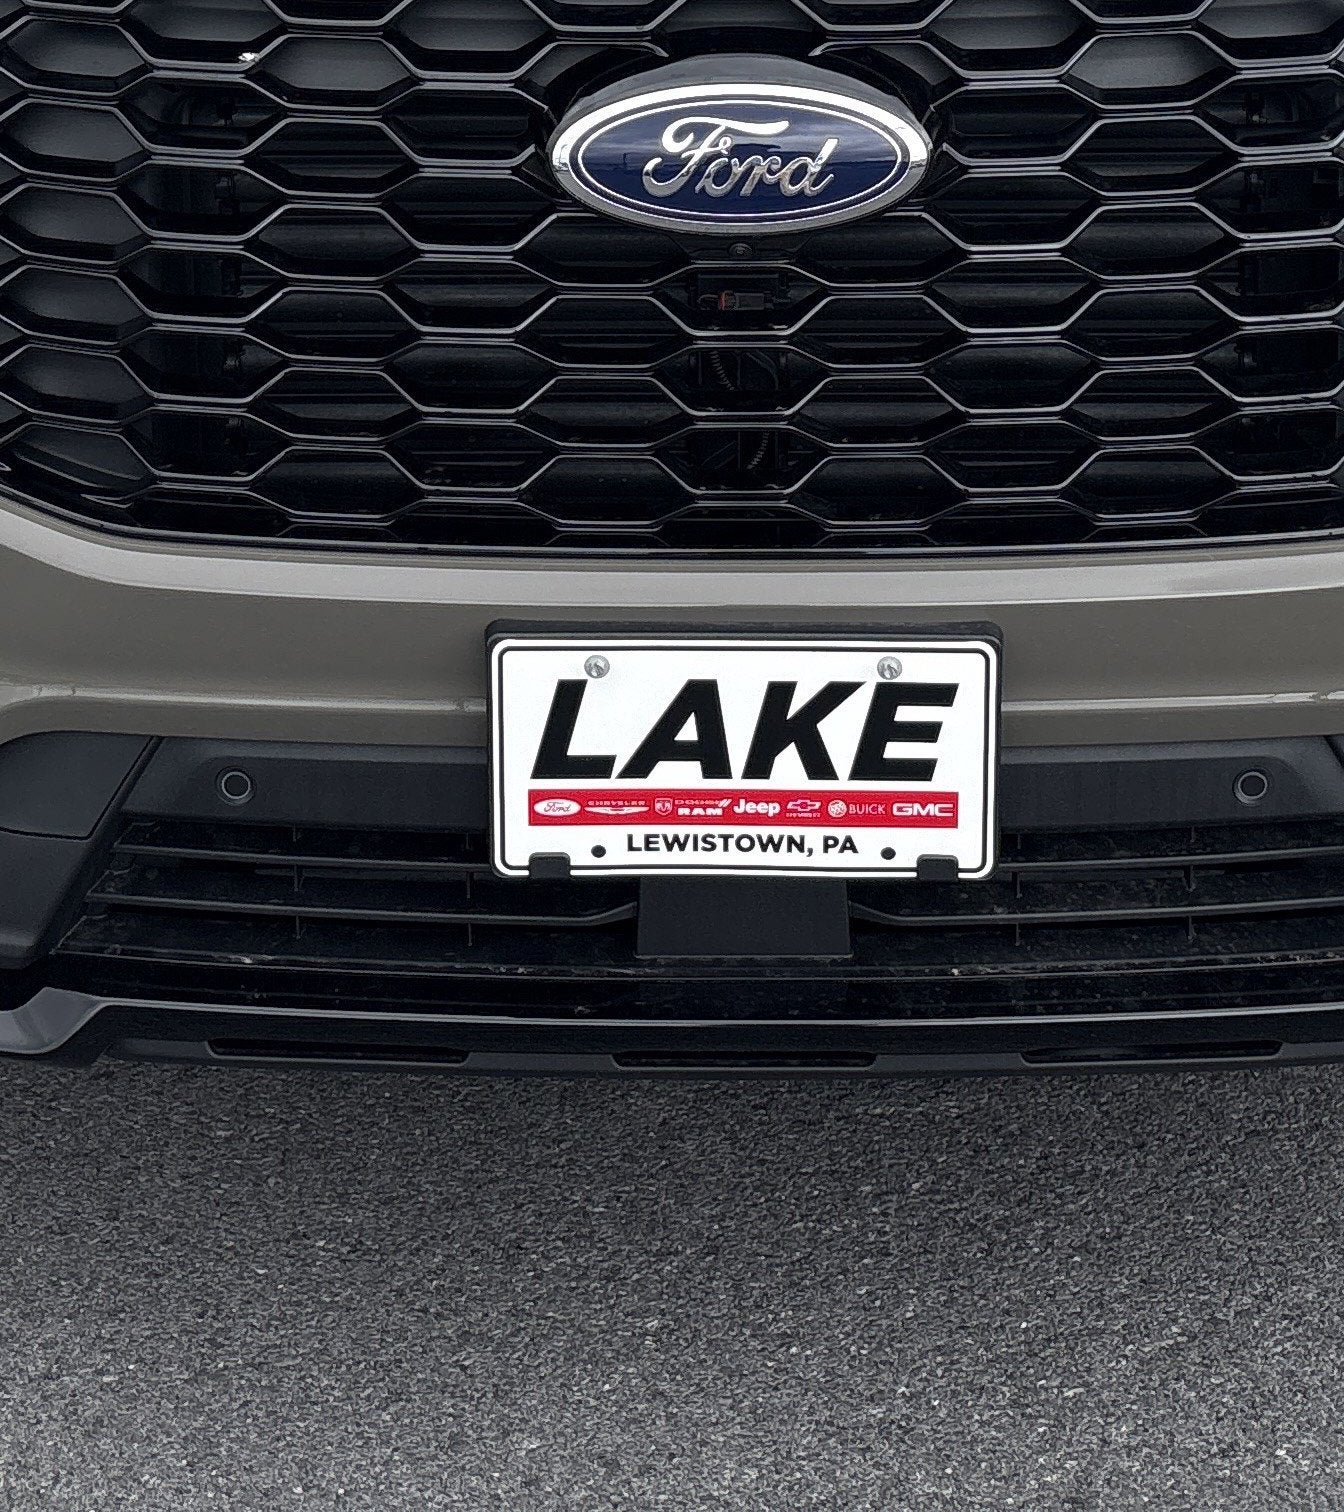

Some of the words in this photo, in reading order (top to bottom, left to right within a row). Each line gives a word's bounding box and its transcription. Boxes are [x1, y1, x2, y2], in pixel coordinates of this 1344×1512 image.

[642, 116, 840, 198] Ford
[530, 678, 961, 782] LAKE
[543, 801, 572, 813] Ford
[677, 807, 723, 816] RAM
[733, 798, 781, 817] Jeep
[848, 803, 886, 815] BUICK
[892, 803, 954, 817] GMC
[627, 833, 814, 857] LEWISTOWN,
[822, 835, 859, 854] PA
